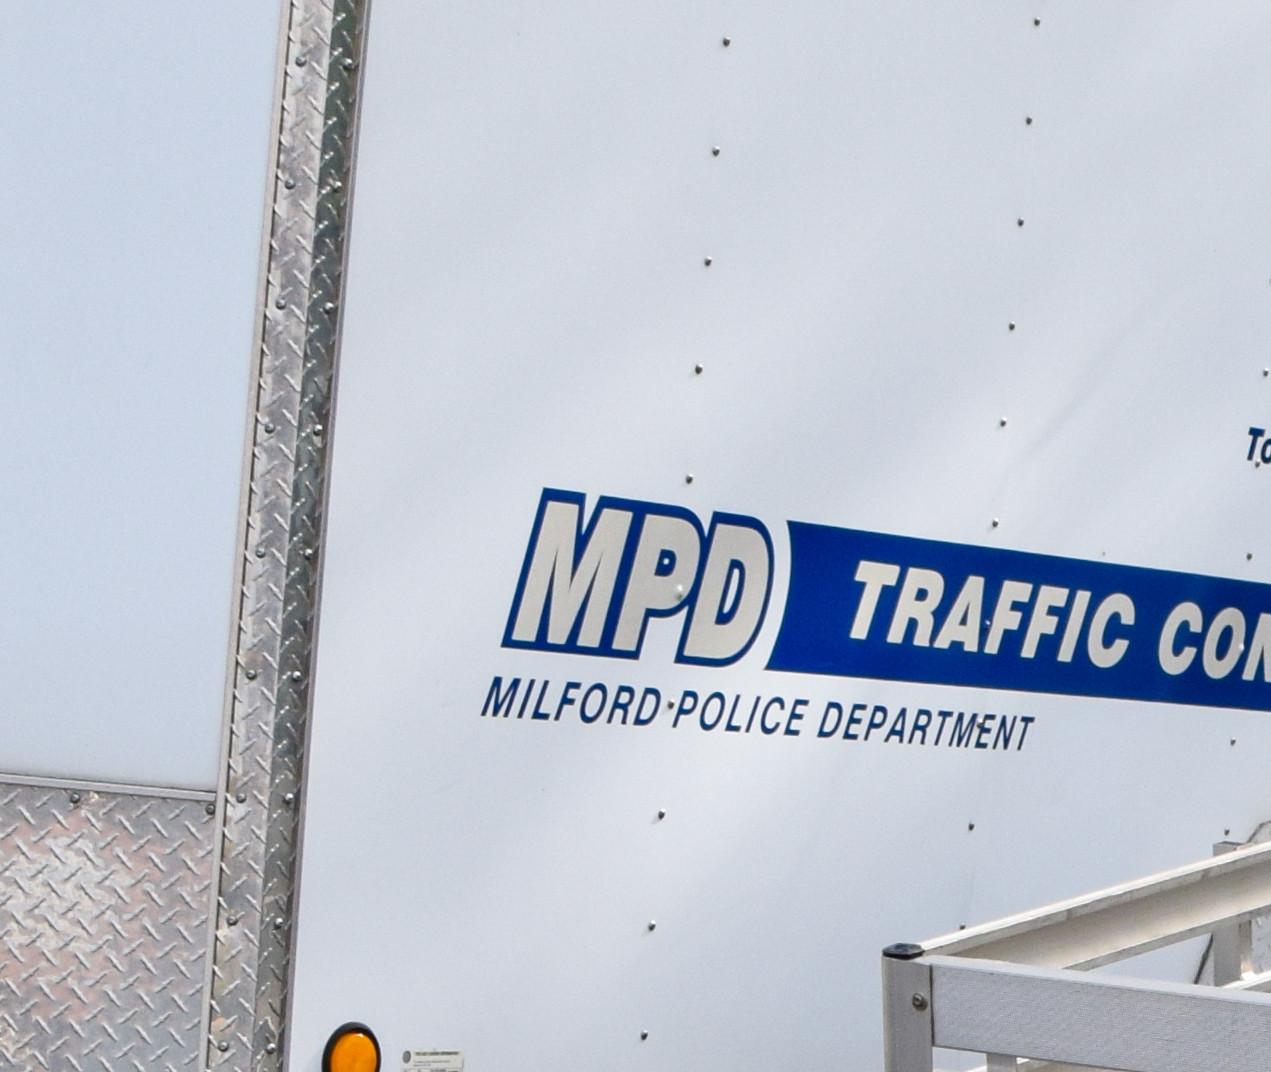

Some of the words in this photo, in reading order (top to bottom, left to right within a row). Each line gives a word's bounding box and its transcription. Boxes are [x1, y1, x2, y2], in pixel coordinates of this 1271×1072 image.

[500, 487, 774, 667] MPD
[850, 560, 1135, 669] TRAFFIC
[481, 676, 661, 726] MILFORD
[672, 691, 808, 735] POLICE
[817, 702, 1034, 751] DEPARTMENT
